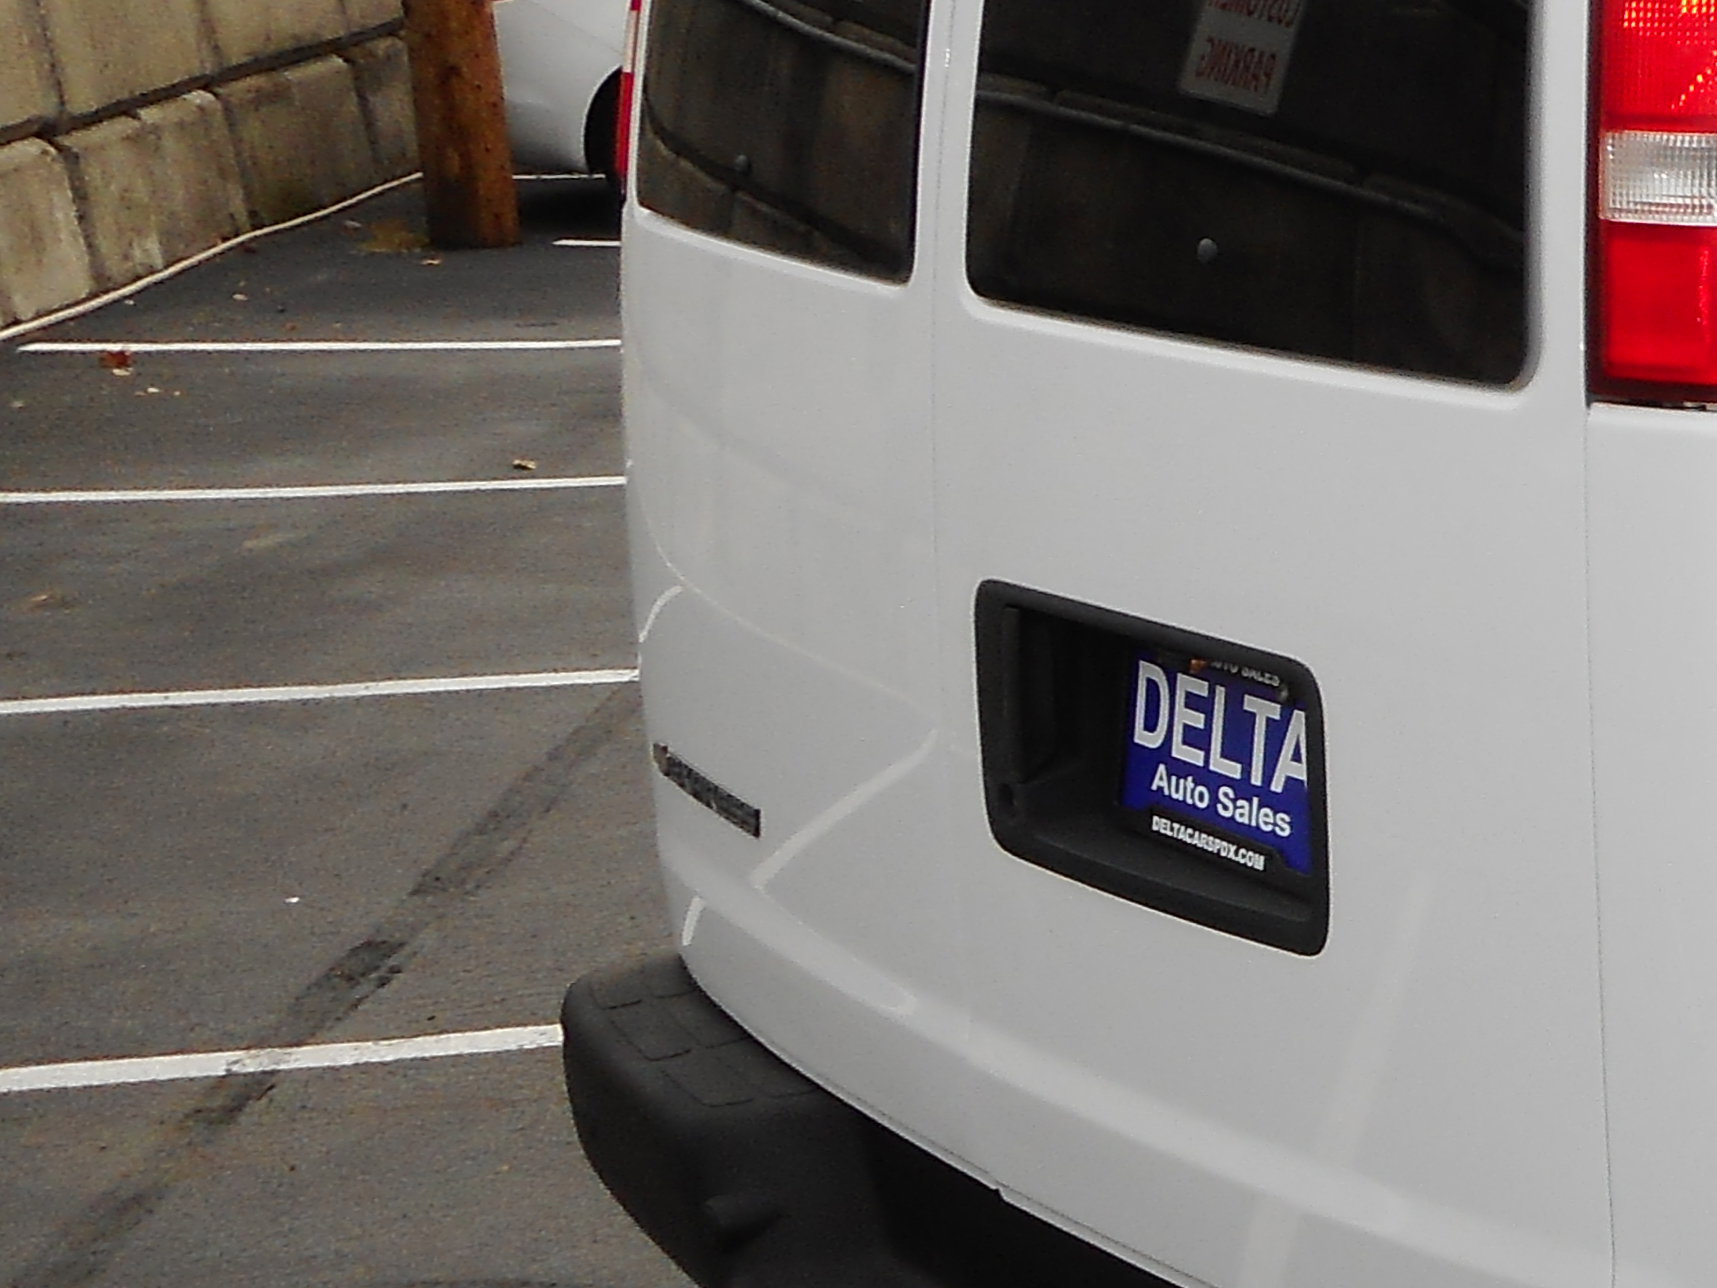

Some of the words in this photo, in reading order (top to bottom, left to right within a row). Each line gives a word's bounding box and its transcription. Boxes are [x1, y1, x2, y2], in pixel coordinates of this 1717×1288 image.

[1132, 659, 1308, 794] DELTA
[1151, 762, 1210, 810] Auto
[1215, 785, 1291, 838] Sales
[1151, 814, 1266, 872] DELTACARSPDX.COM
